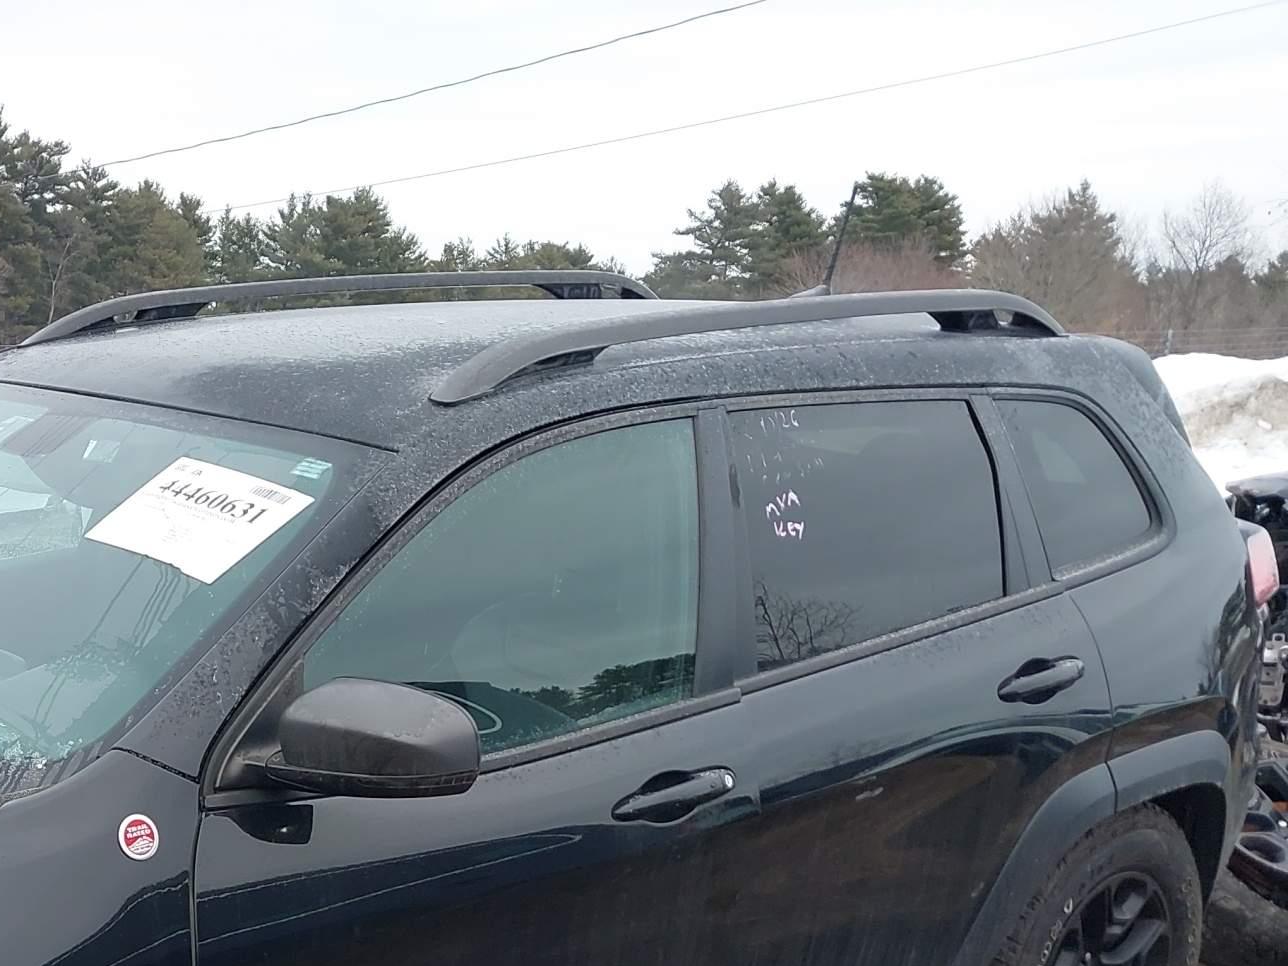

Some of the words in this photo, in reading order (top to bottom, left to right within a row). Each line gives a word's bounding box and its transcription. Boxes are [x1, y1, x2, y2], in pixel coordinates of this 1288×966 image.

[158, 479, 270, 525] 44460631
[773, 520, 805, 540] KEY
[126, 823, 149, 834] TRAIL
[126, 828, 152, 839] RATED
